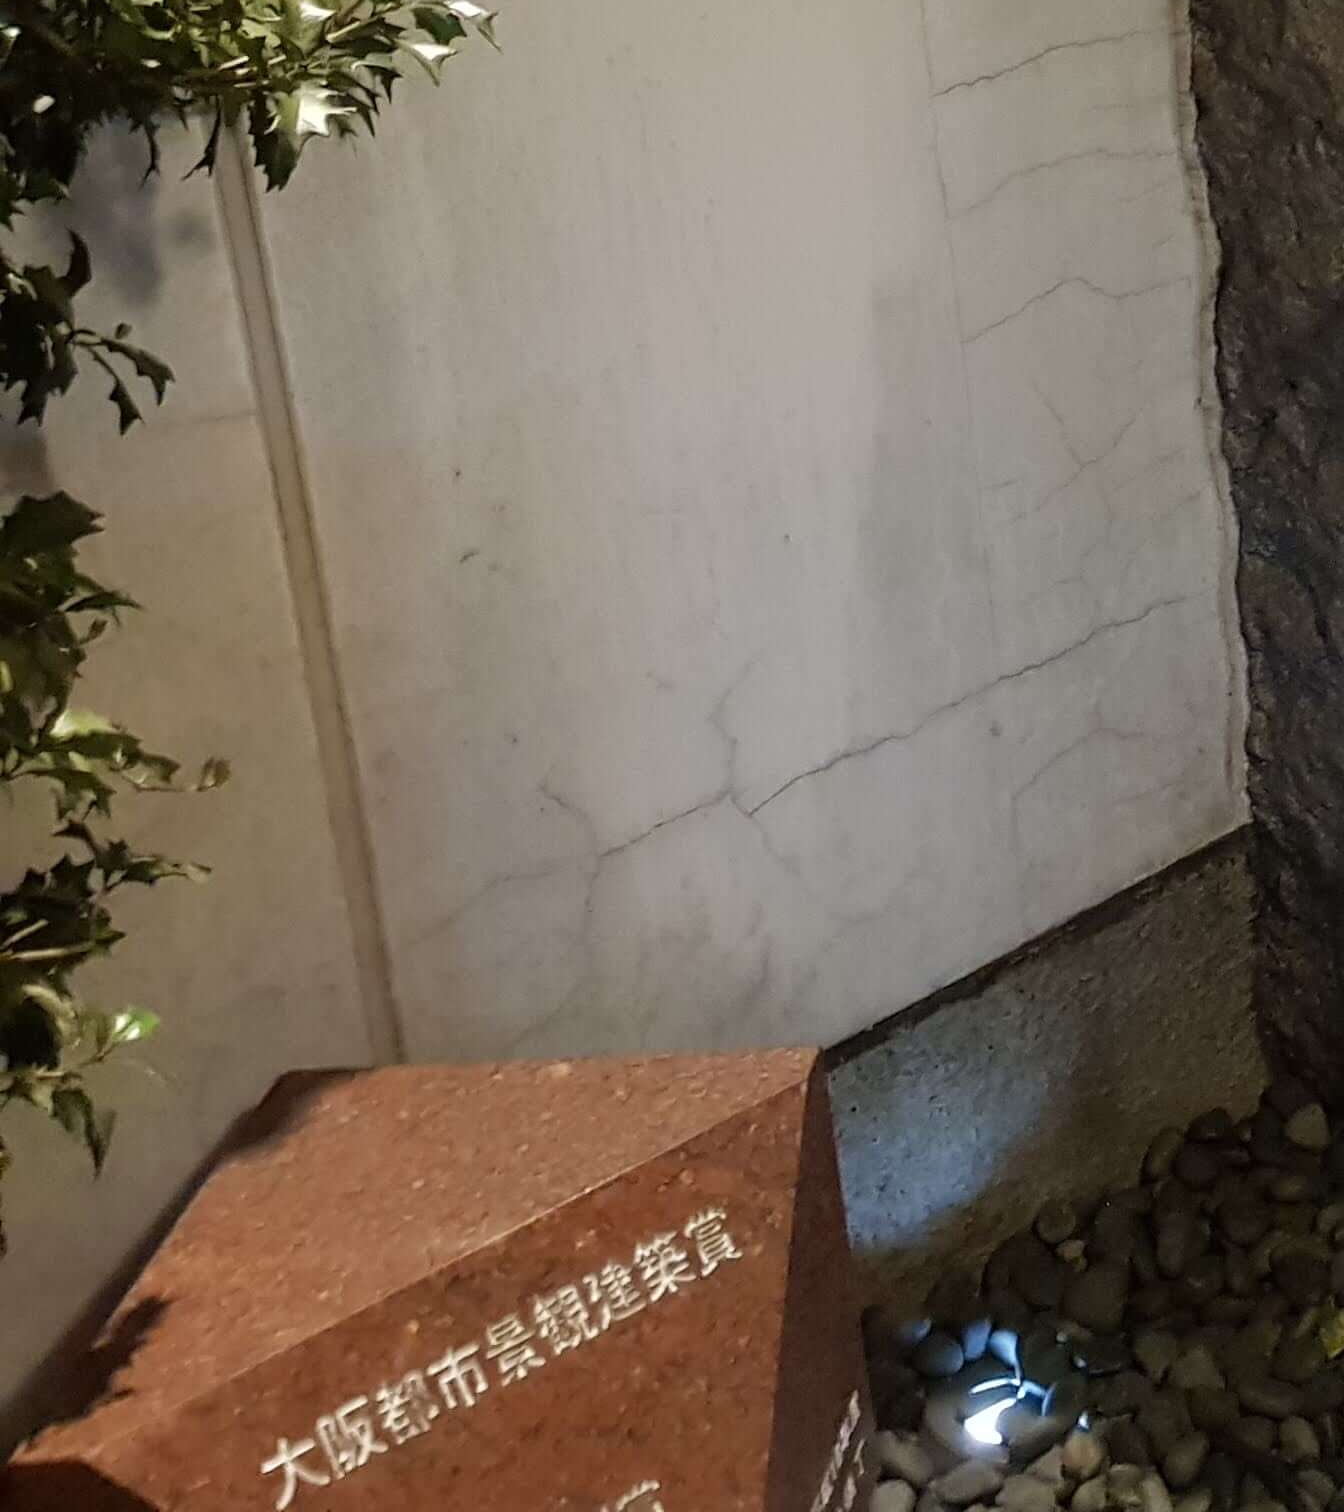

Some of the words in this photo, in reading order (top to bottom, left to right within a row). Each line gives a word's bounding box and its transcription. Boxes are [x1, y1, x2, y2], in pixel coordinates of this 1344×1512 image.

[260, 1206, 744, 1511] 大阪都市景観建築賞
